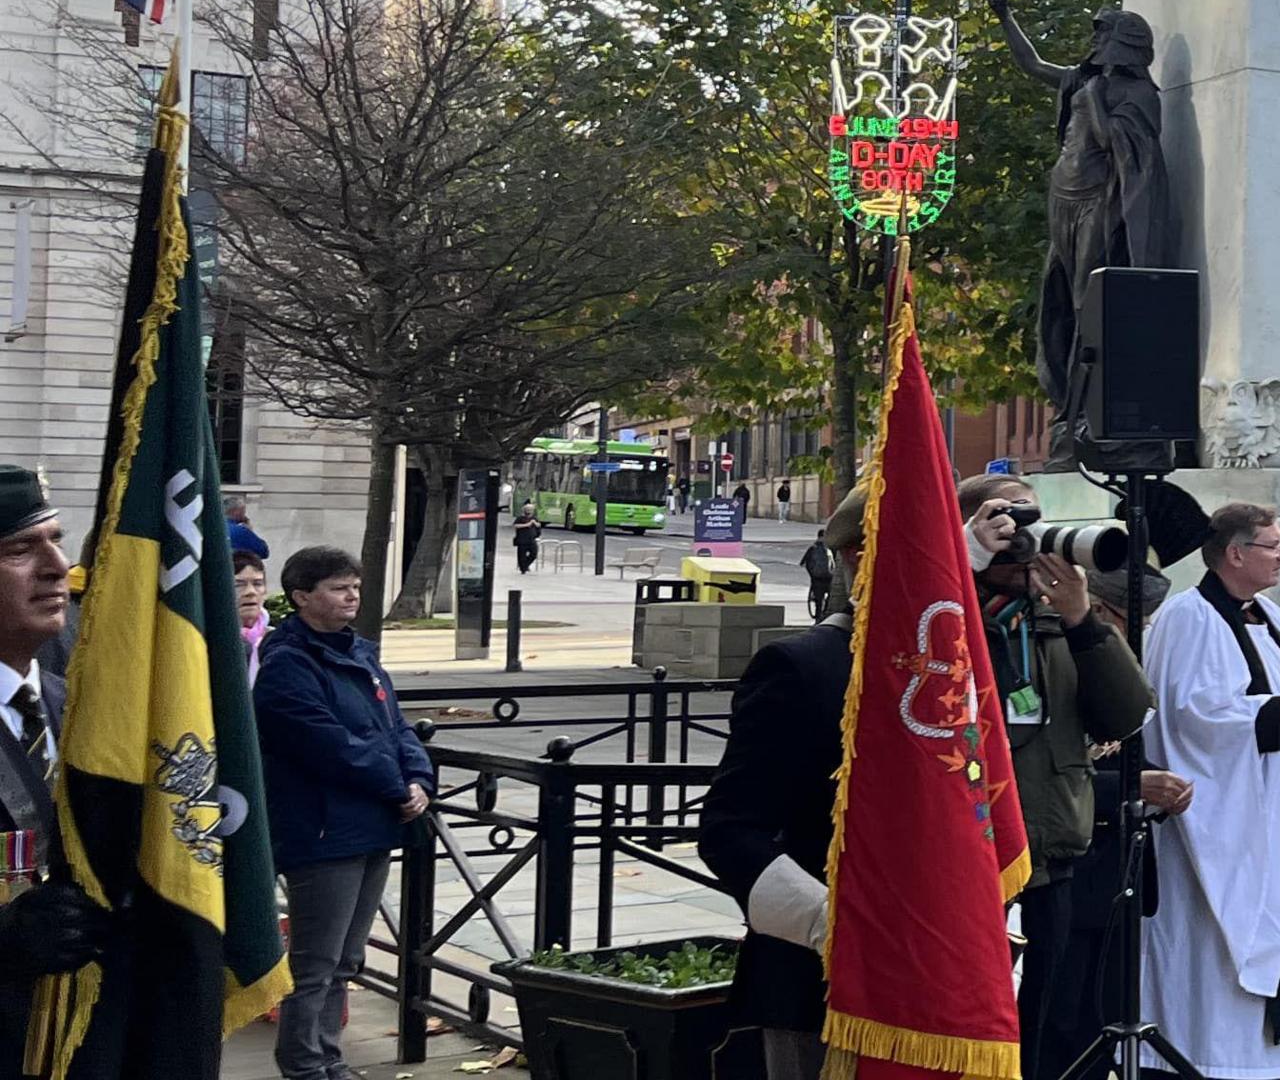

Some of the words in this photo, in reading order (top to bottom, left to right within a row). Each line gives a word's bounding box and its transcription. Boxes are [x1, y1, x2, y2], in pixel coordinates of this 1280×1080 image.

[829, 115, 847, 136] 6
[847, 117, 900, 137] JUNE
[899, 118, 959, 140] 1944
[852, 141, 942, 169] D-DAY
